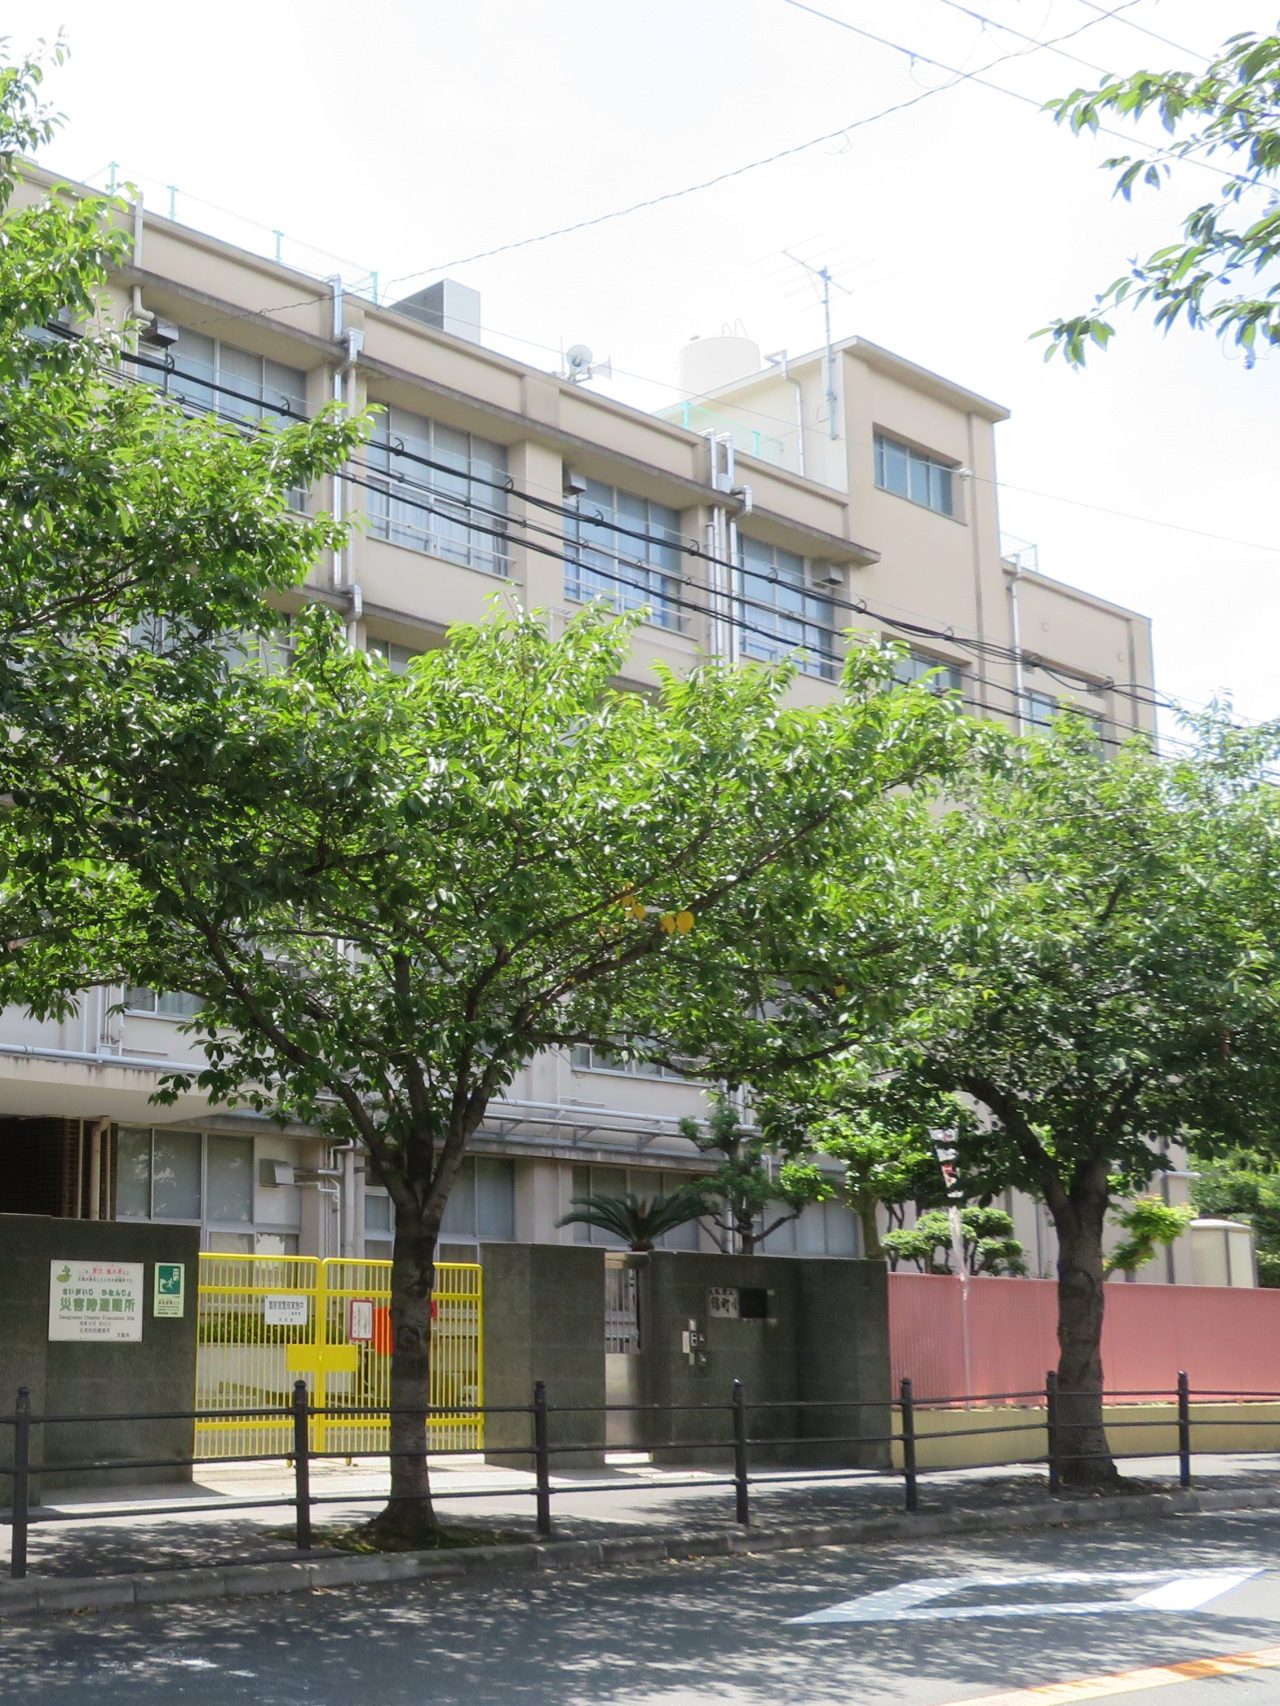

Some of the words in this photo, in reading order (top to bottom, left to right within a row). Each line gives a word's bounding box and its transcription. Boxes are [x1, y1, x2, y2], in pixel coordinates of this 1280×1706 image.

[59, 1297, 135, 1312] 災害時避難所
